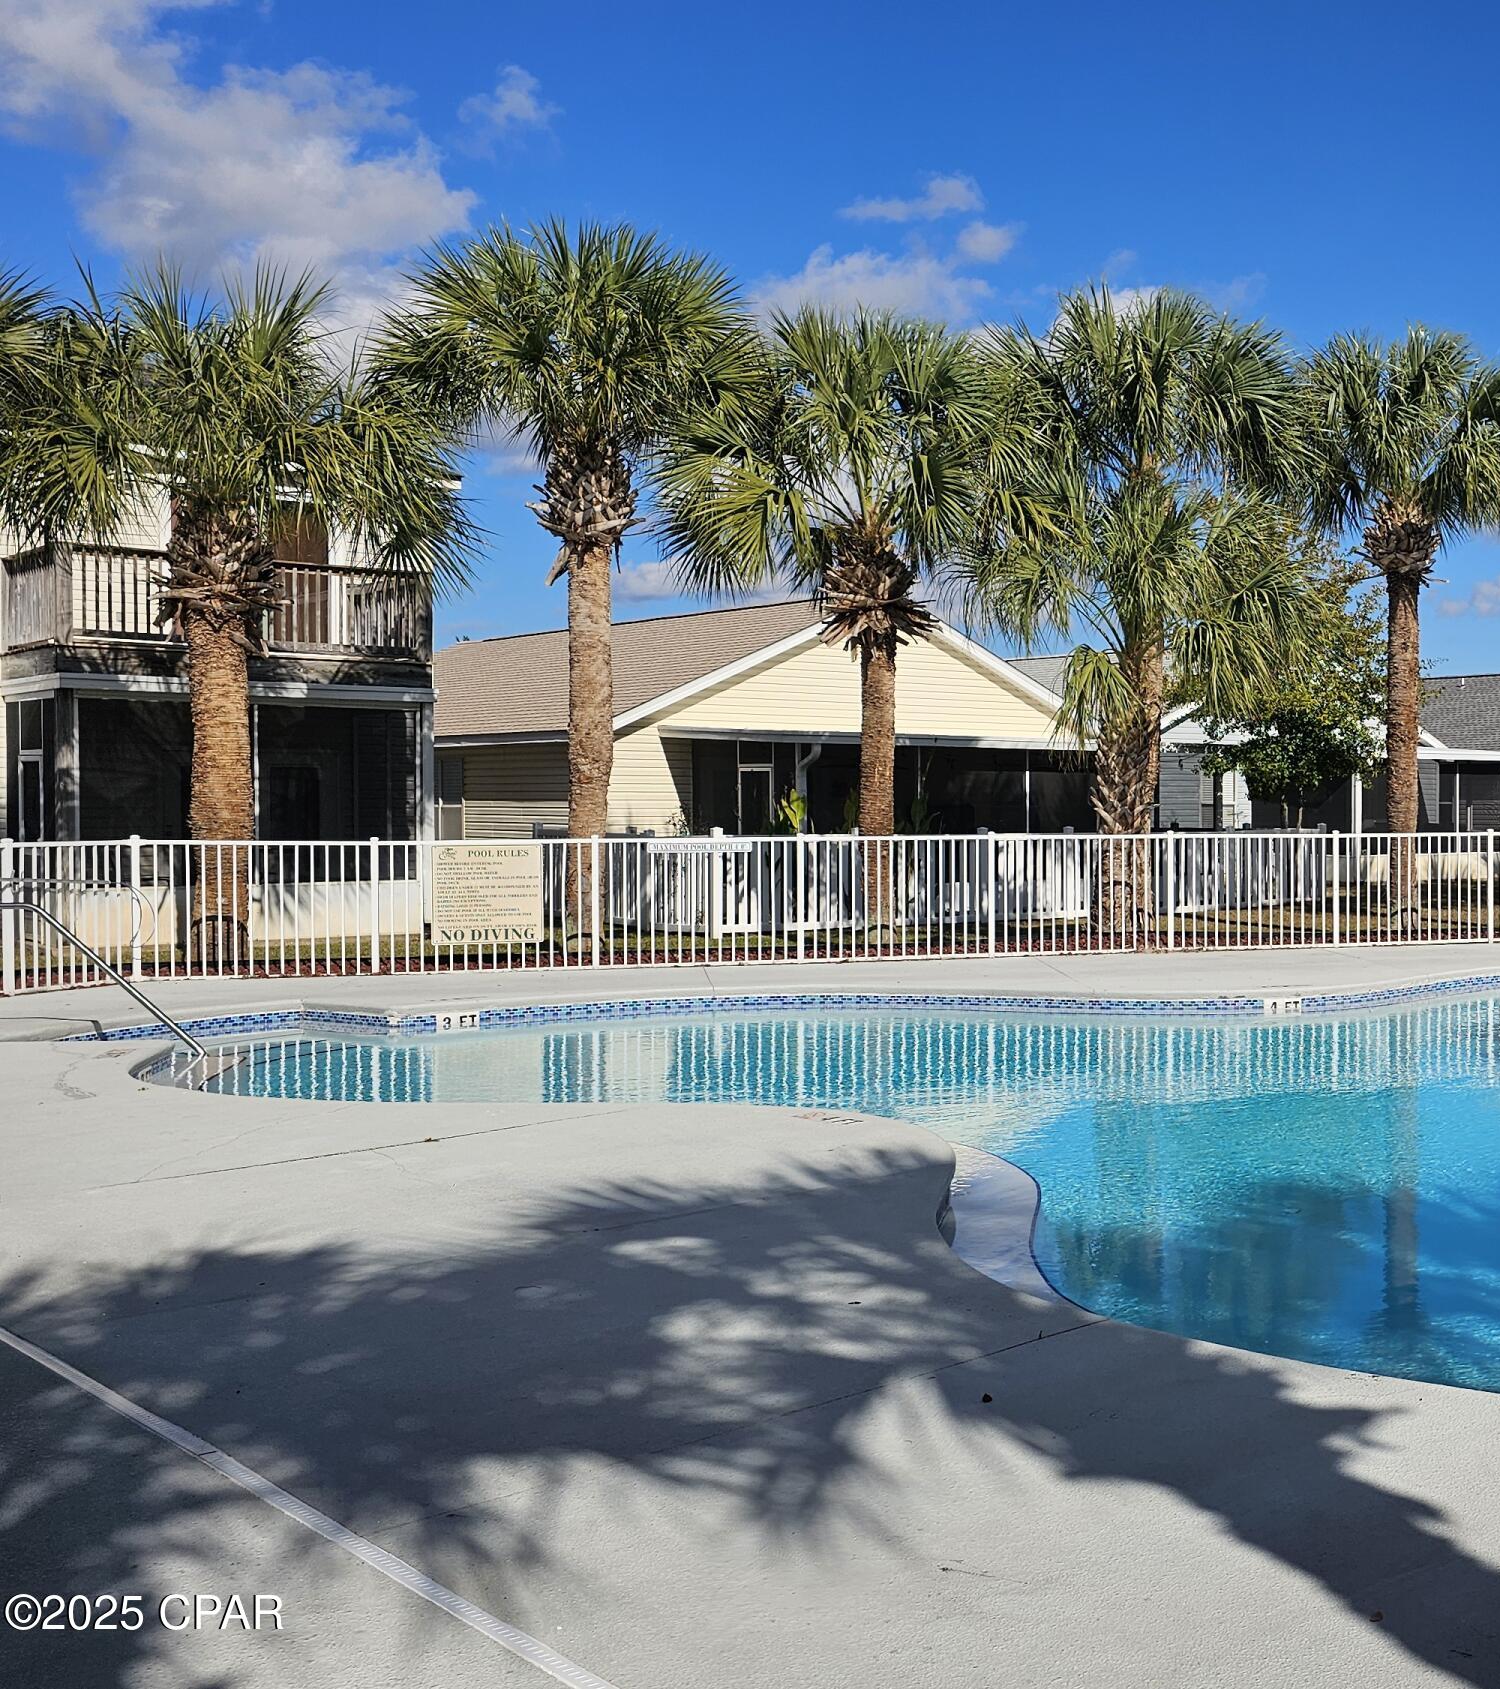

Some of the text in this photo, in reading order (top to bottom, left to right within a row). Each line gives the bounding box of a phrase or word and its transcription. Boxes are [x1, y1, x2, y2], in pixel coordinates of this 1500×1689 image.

[468, 849, 494, 858] POOL
[497, 849, 529, 857] RULES
[440, 927, 535, 942] NO DIVING
